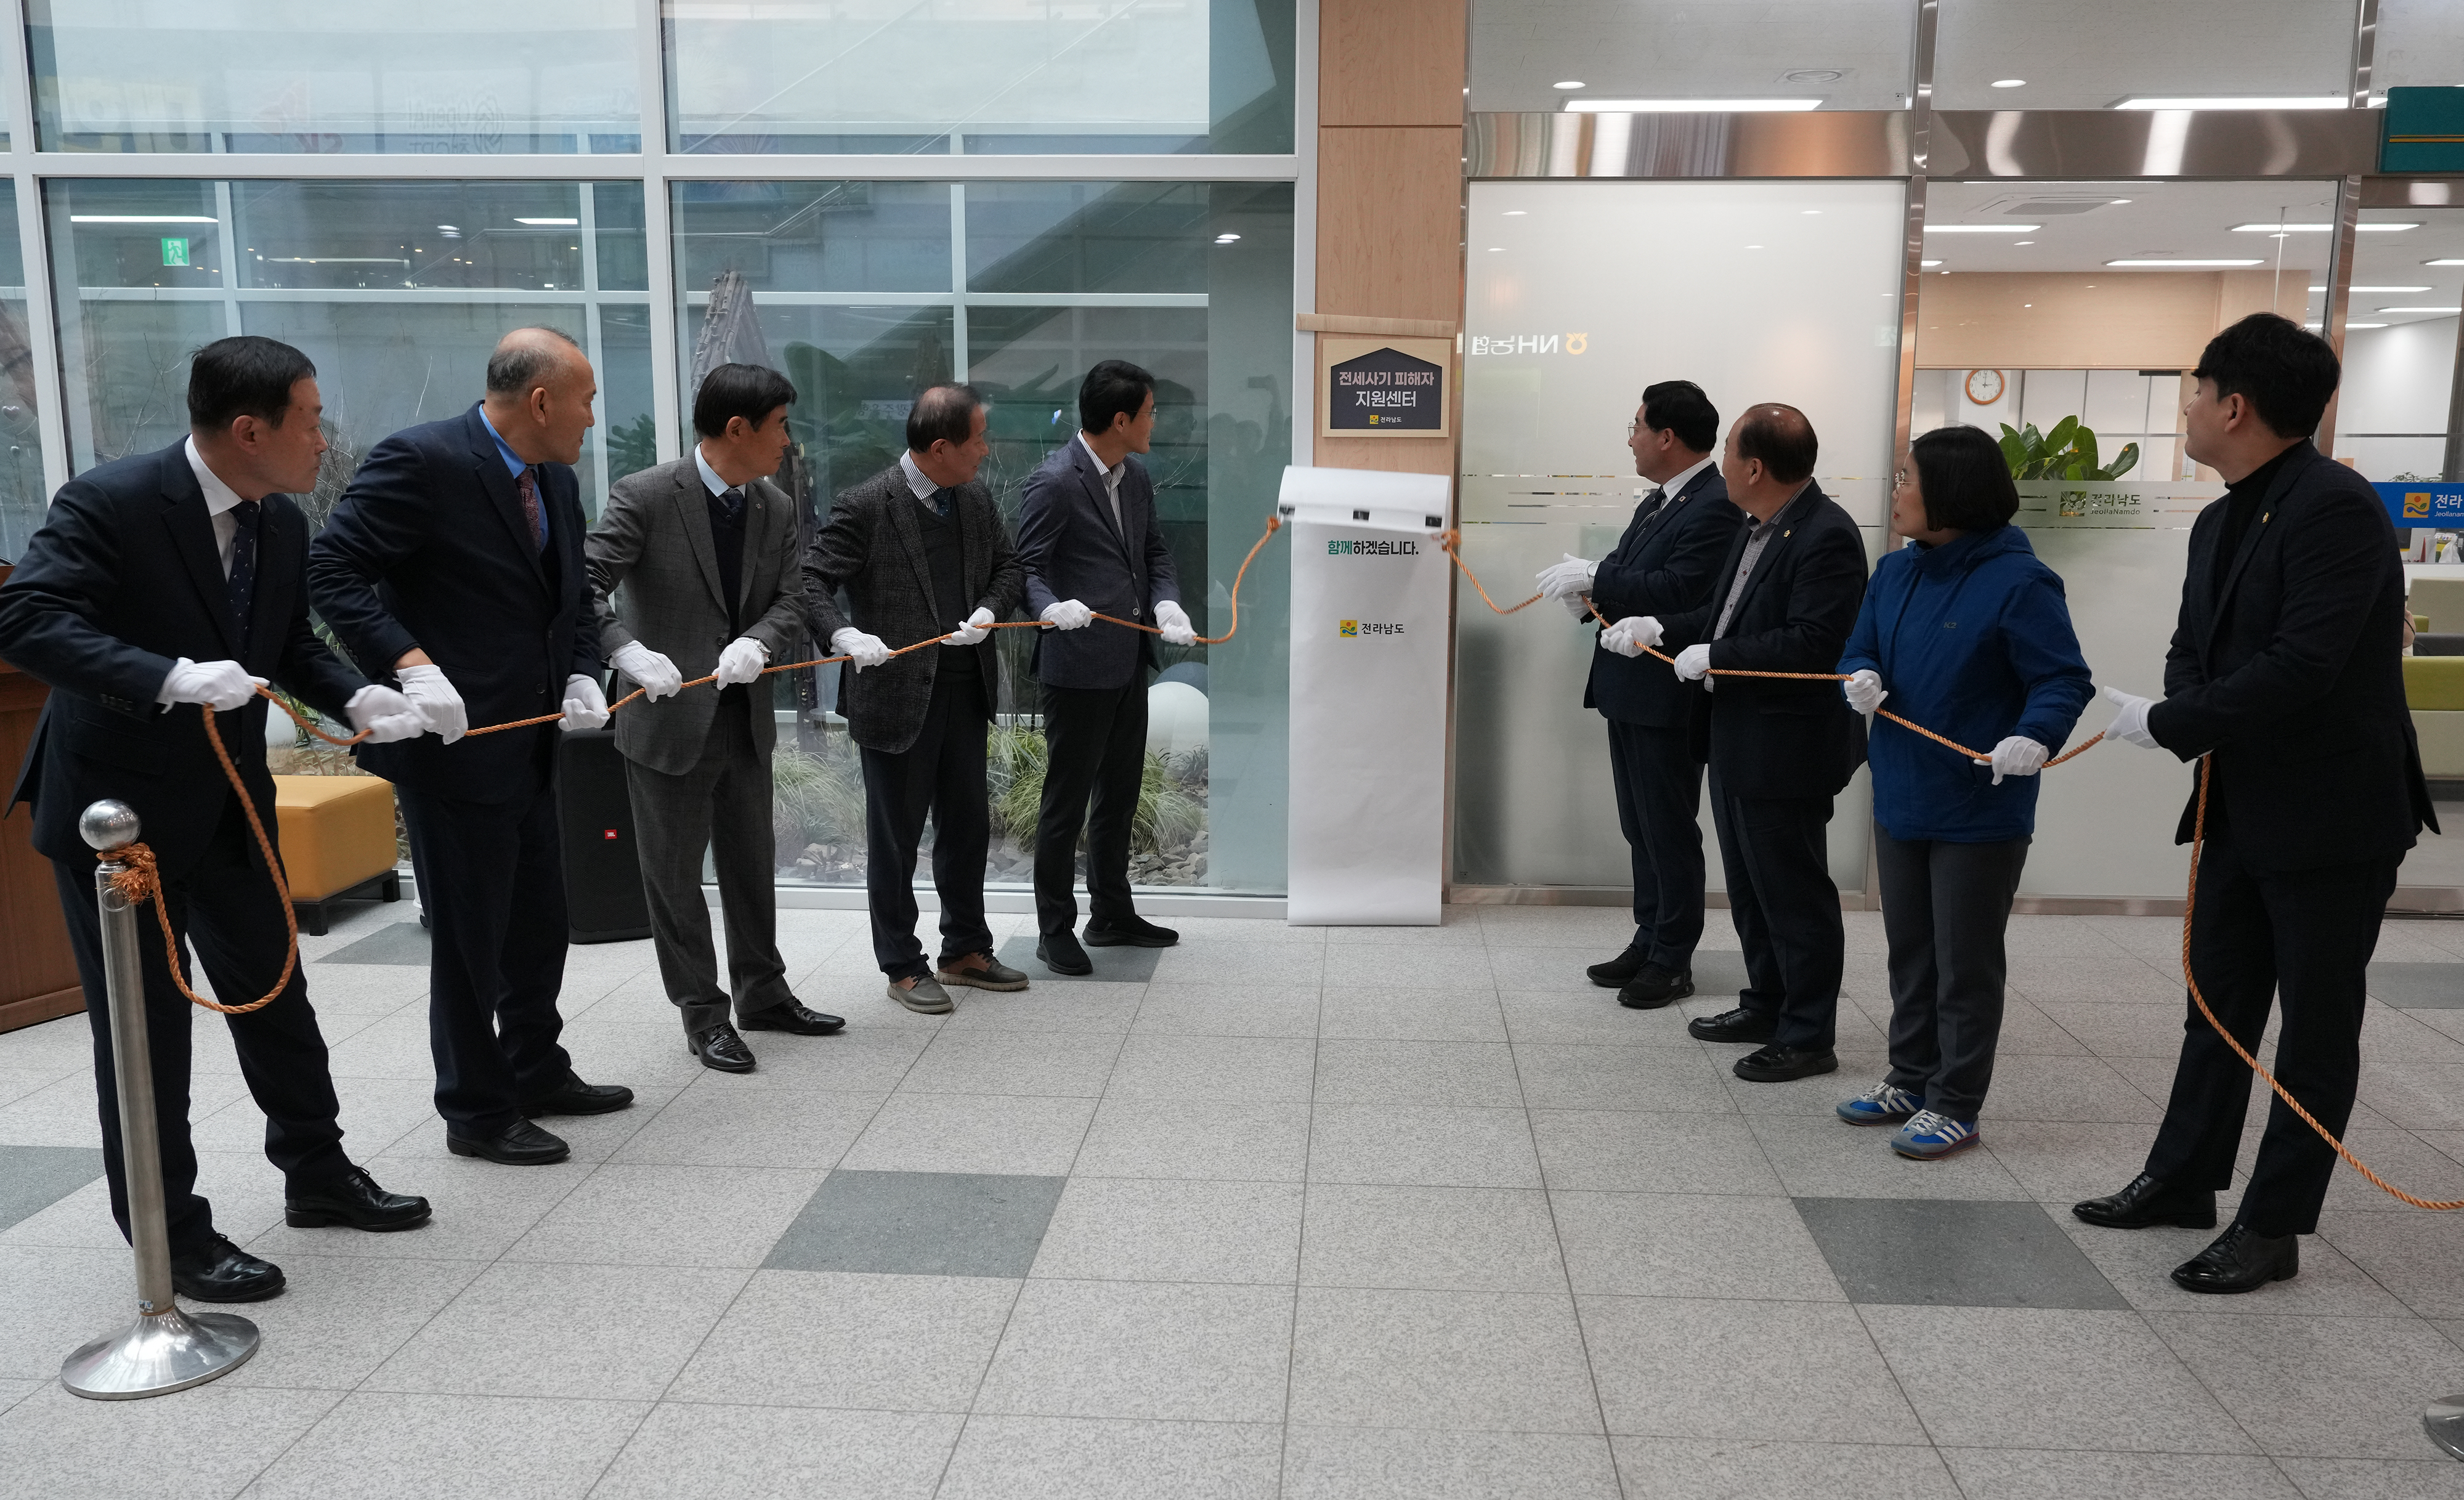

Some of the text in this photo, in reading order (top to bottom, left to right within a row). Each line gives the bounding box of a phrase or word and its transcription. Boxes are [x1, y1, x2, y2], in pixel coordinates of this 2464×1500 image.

[1339, 371, 1435, 386] 전세사기 피해자
[1355, 391, 1416, 407] 지원센터
[2091, 493, 2141, 507] 전라남도
[1327, 540, 1419, 555] 함께하겠습니다.
[1361, 623, 1404, 635] 전라남도
